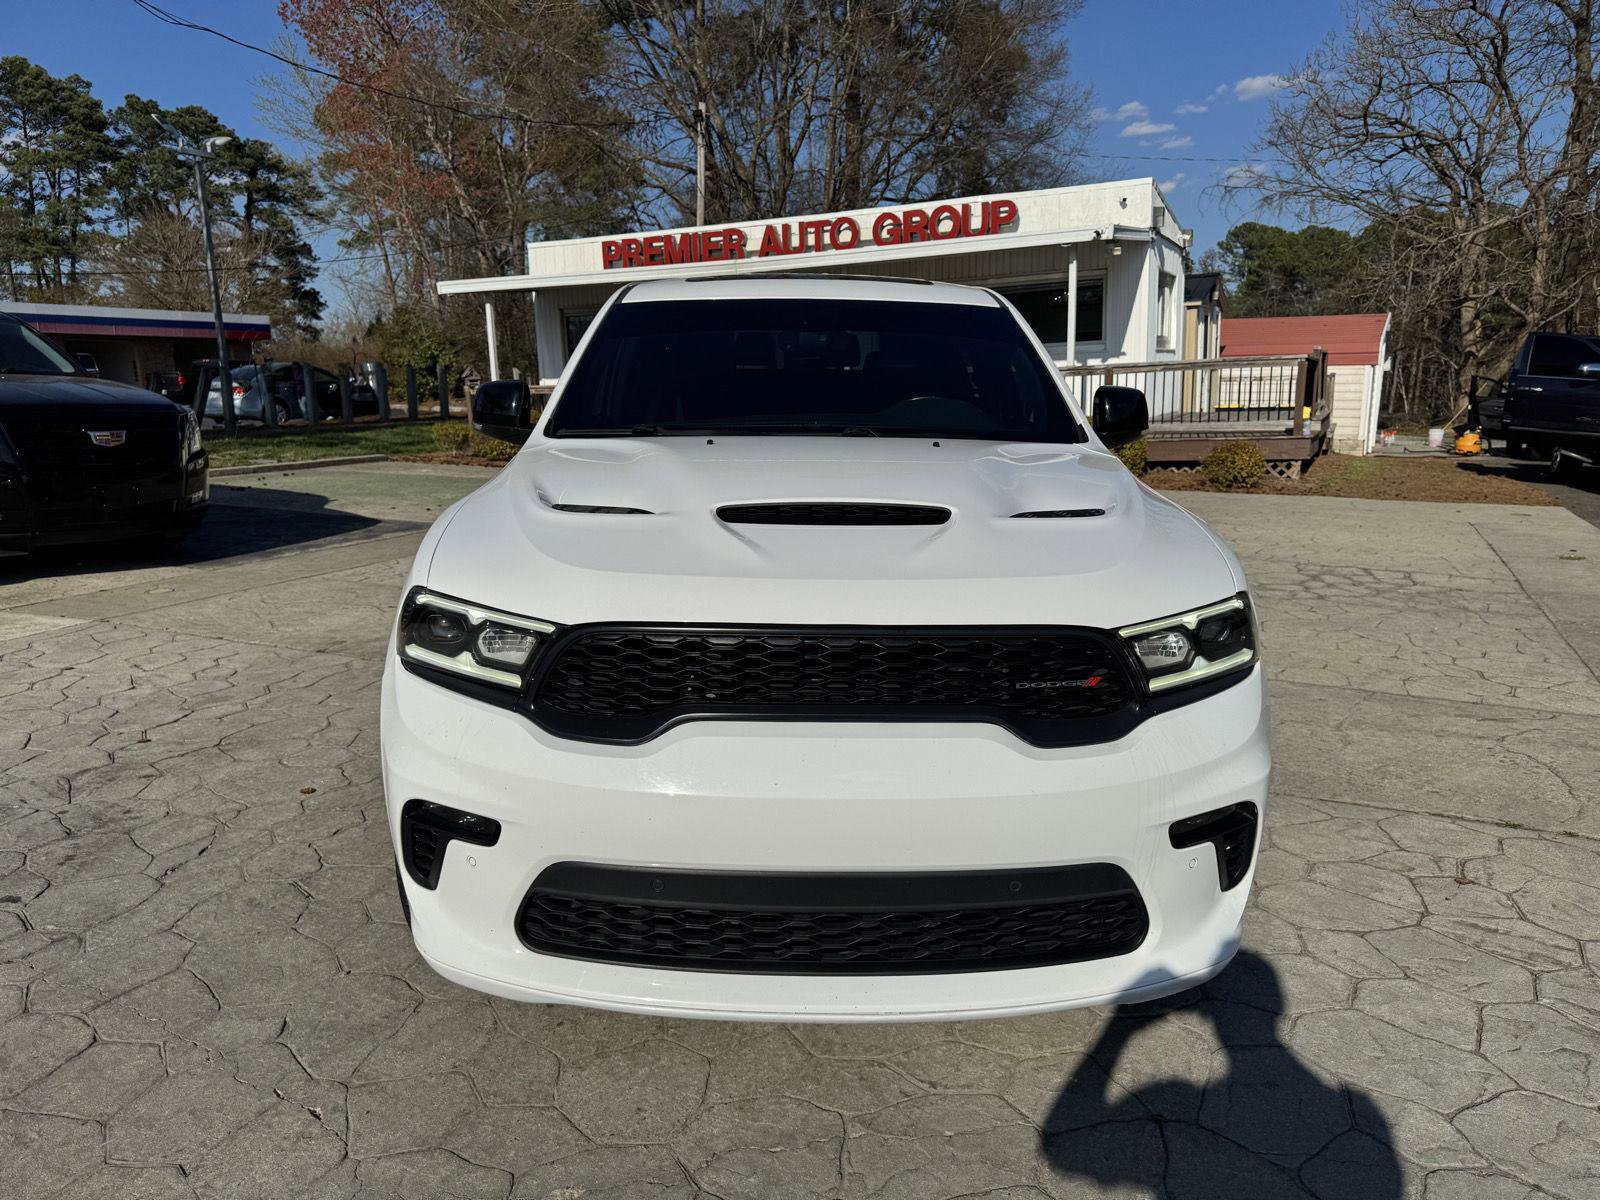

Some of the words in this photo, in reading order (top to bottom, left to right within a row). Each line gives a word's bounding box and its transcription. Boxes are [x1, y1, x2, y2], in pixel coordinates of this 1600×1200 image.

[602, 228, 747, 269] PREMIER
[758, 217, 860, 257] AUTO
[872, 200, 1018, 246] GROUP
[1015, 679, 1090, 689] DODGE
